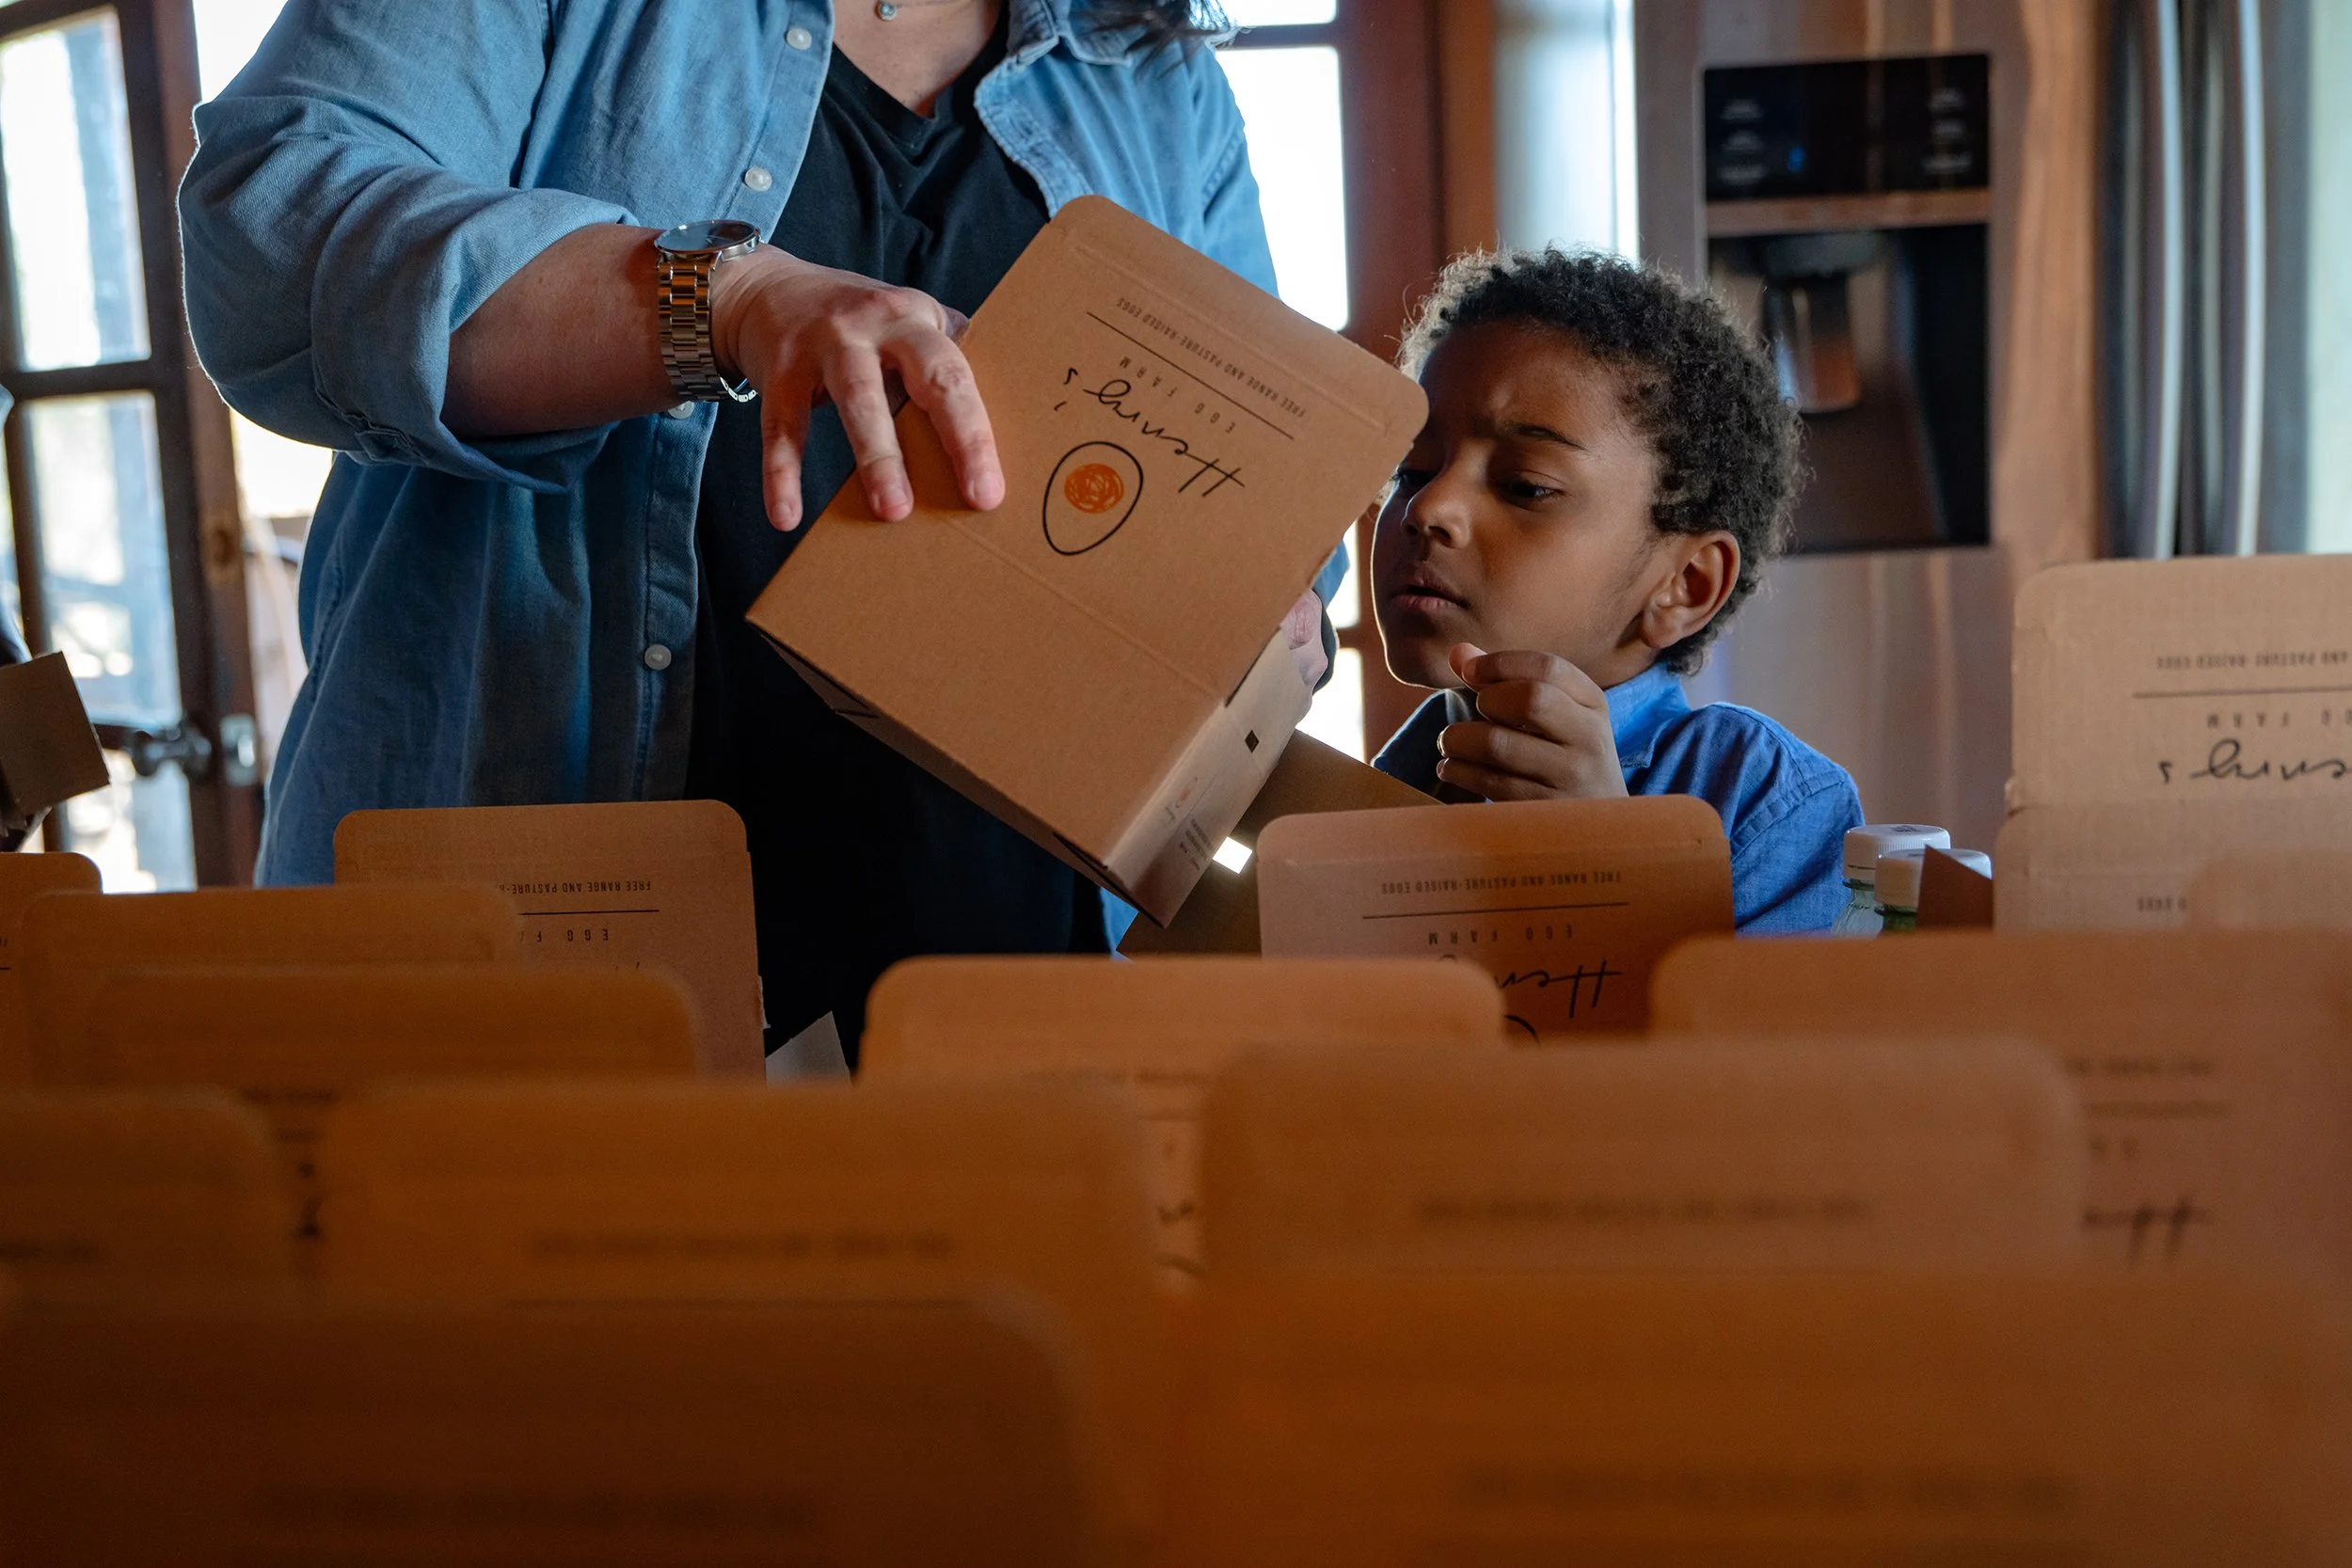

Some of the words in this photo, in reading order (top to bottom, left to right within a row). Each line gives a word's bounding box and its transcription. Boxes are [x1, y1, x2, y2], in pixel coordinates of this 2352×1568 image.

[1117, 297, 1142, 318] EGGS
[1143, 314, 1223, 369] PASTURE-RAISED
[1119, 356, 1178, 398] FARM
[1224, 363, 1244, 381] AND
[1247, 375, 1278, 403] RANGE
[1279, 396, 1307, 419] FREE
[1194, 403, 1236, 434] EGG
[1054, 367, 1246, 498] Henry's
[627, 880, 651, 892] FREE
[1594, 871, 1621, 884] FREE
[563, 882, 581, 893] AND
[587, 881, 621, 893] RANGE
[566, 928, 609, 942] EGG
[1429, 929, 1498, 945] FARM
[1525, 925, 1572, 941] EGG
